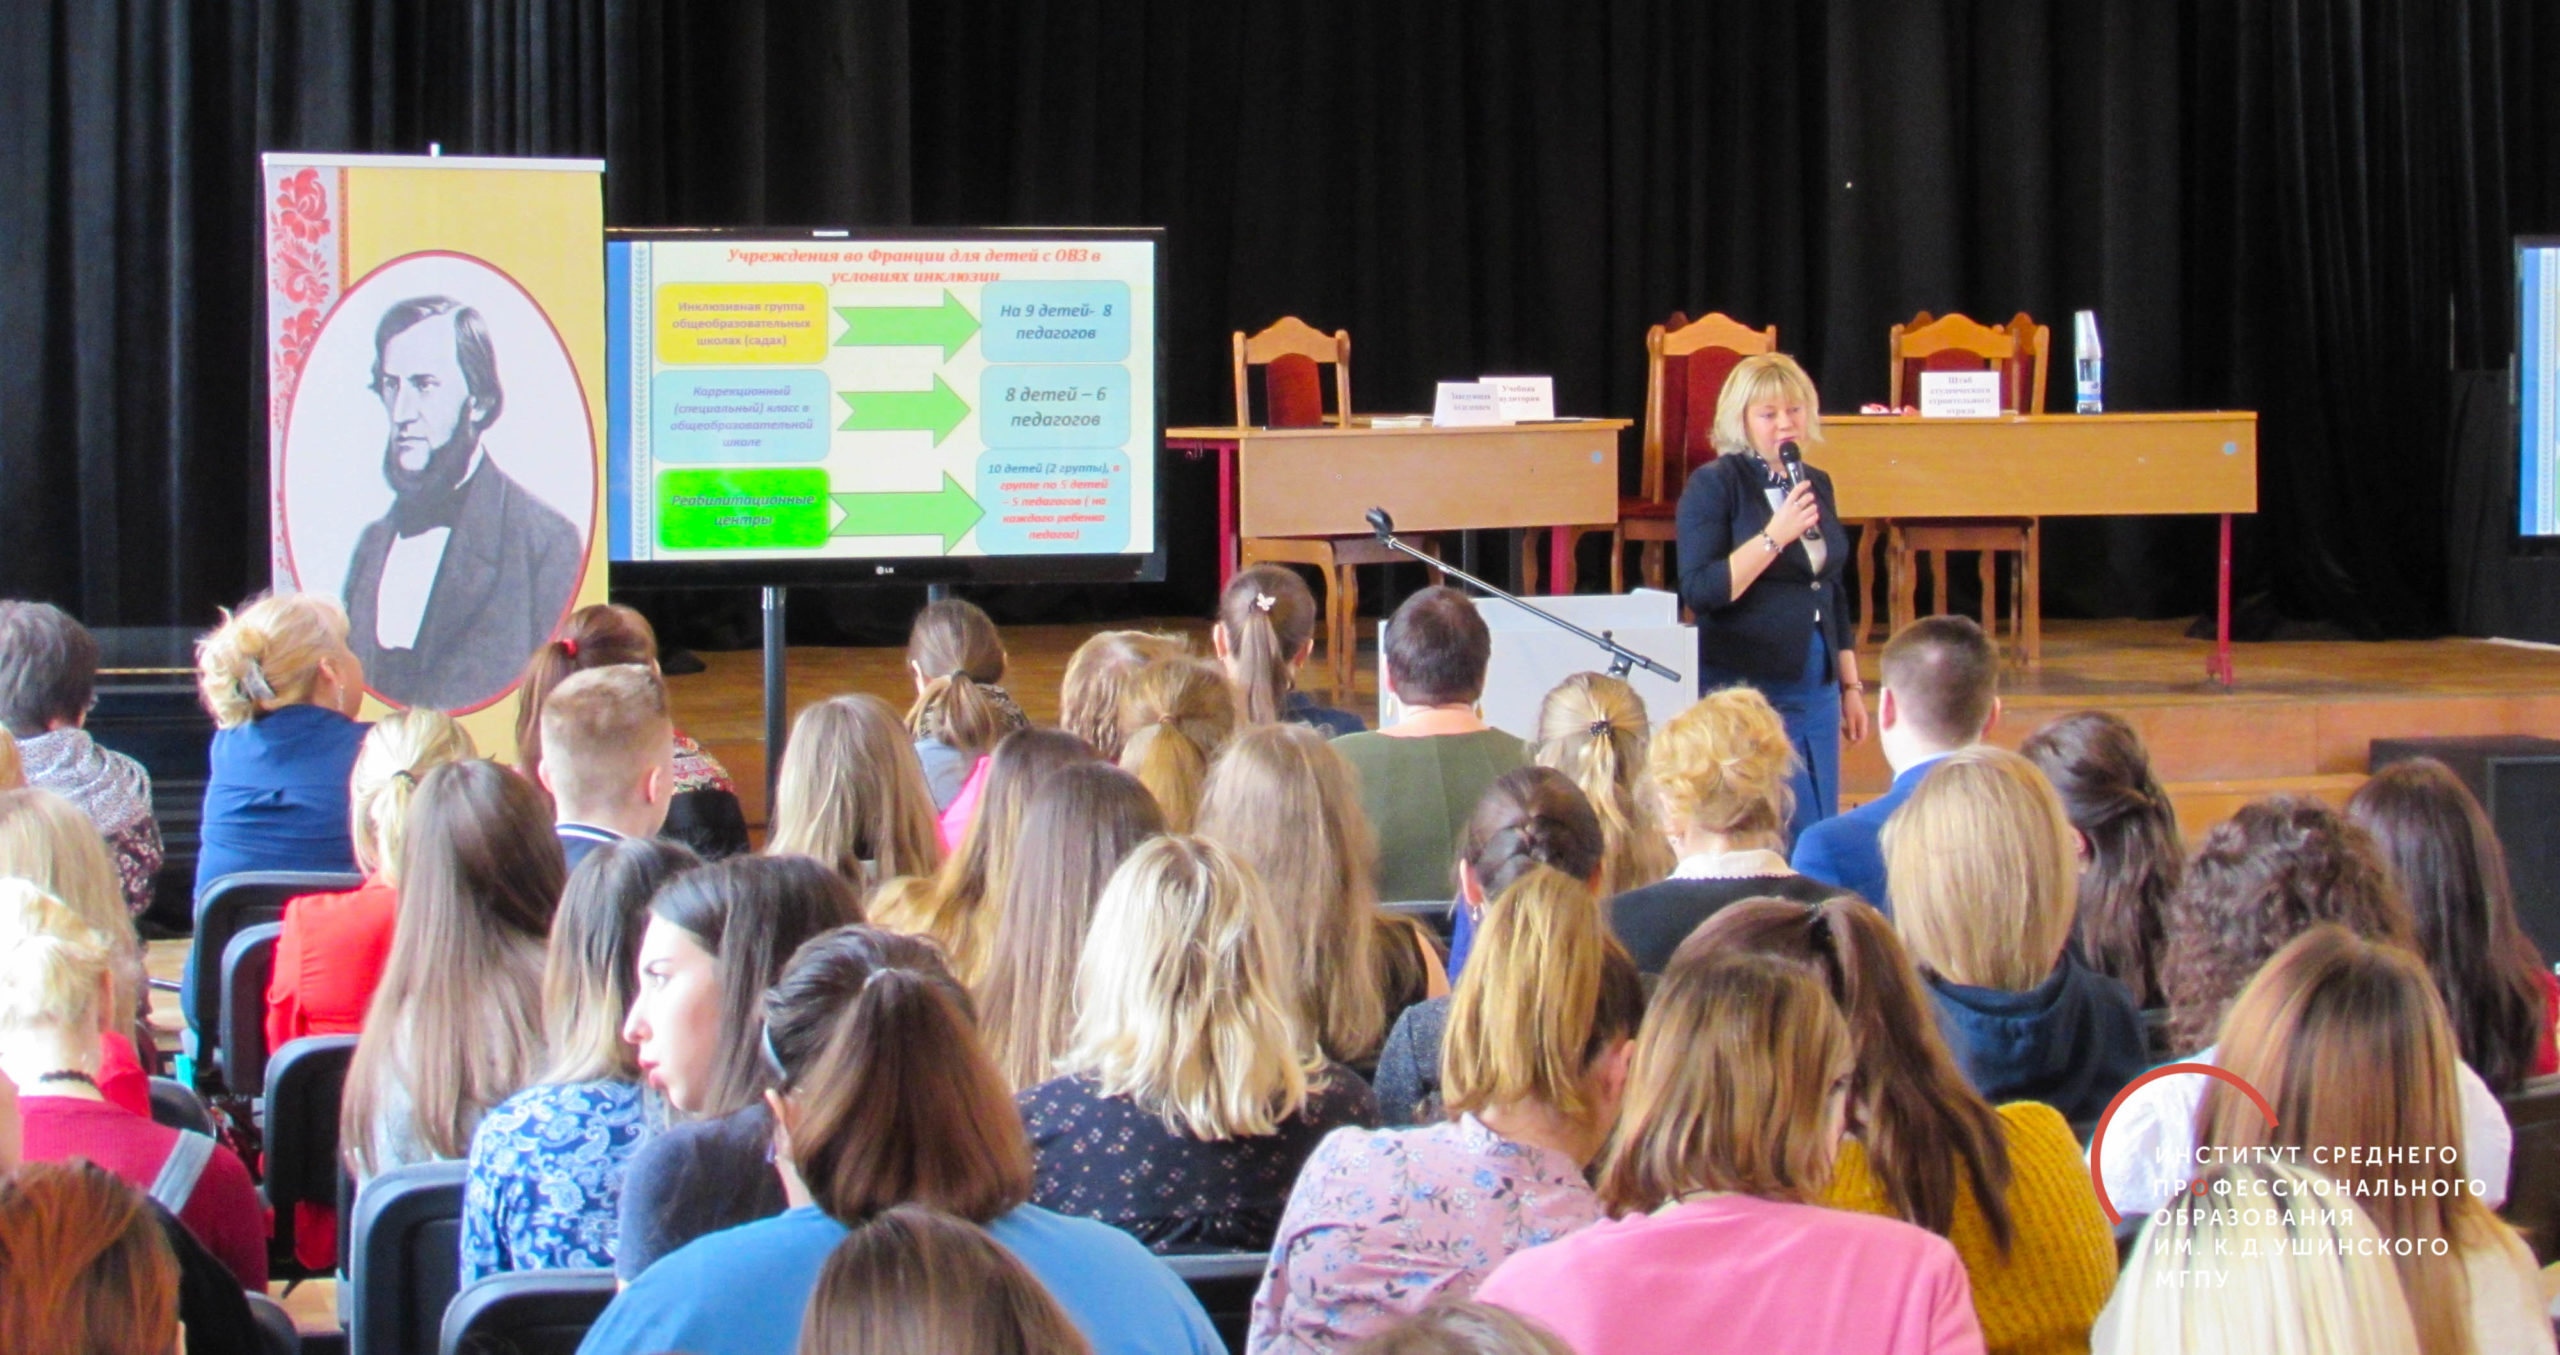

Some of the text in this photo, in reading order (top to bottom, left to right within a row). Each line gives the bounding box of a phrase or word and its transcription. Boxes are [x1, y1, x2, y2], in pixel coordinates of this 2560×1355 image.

[727, 248, 1101, 265] Учреждения во Франции для детей с ОВЗ в
[829, 271, 1001, 286] условиях инклюзии
[678, 302, 805, 313] Инклюзивная группа
[1000, 303, 1112, 317] На 9 детей- 8
[672, 318, 811, 330] общеобразовательных
[1016, 326, 1097, 339] педагогов
[697, 335, 787, 347] школах (садах)
[693, 385, 792, 398] Коррекционный
[1005, 387, 1016, 401] 8
[1020, 386, 1078, 401] детей
[1096, 387, 1107, 401] 6
[674, 403, 810, 415] (специальный) класс в
[1011, 411, 1101, 427] педагогов
[670, 419, 813, 432] общеобразовательной
[723, 438, 762, 447] школе
[988, 464, 1002, 474] 10
[1004, 463, 1043, 473] детей
[1045, 463, 1057, 475] (2
[1059, 463, 1110, 475] группы),
[999, 479, 1109, 491] группе по 5 детей
[672, 494, 816, 507] Реабилитационные
[1012, 497, 1019, 506] 5
[1021, 496, 1081, 507] педагогов
[714, 516, 773, 528] центры
[1002, 512, 1106, 524] каждого ребенка
[1028, 529, 1080, 541] педагог)
